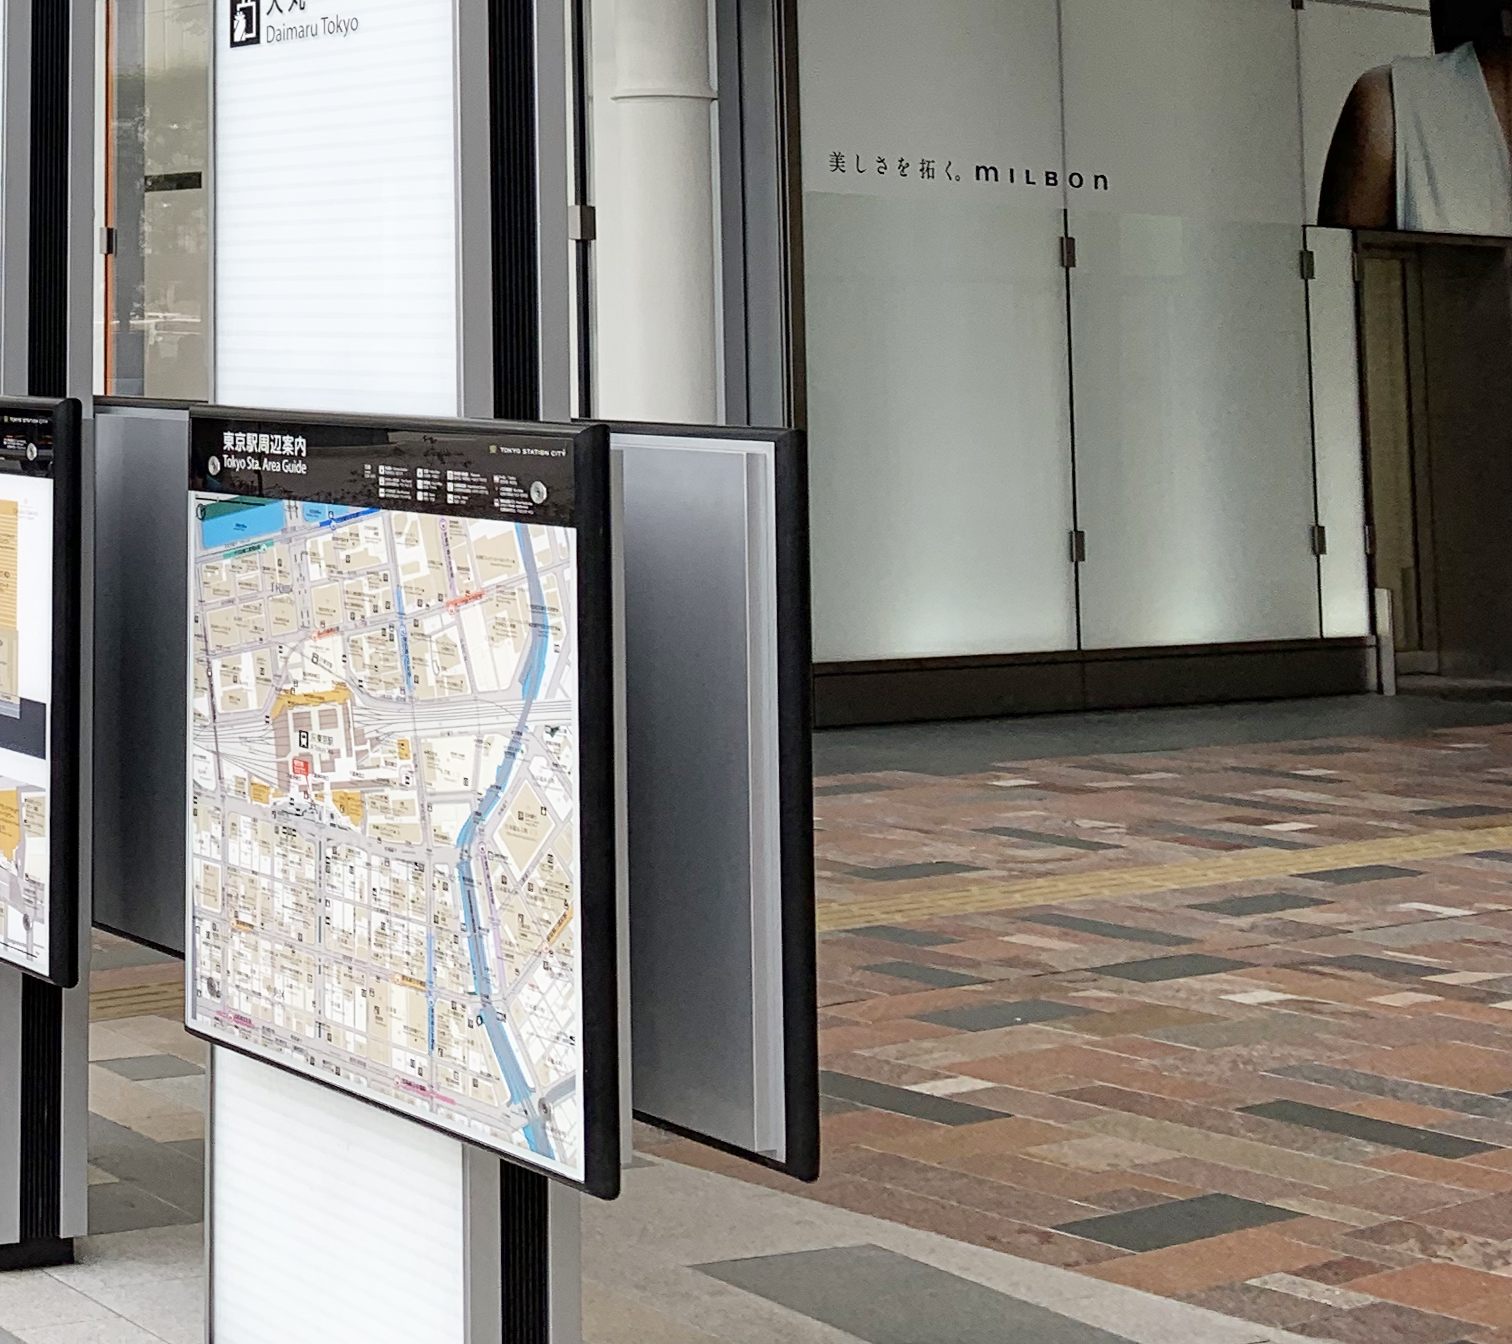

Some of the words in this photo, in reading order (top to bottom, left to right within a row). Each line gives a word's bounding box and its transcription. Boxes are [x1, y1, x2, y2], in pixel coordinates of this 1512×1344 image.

[266, 18, 318, 43] Daimaru
[321, 14, 359, 37] Tokyo
[499, 446, 521, 455] TOKYO
[522, 448, 549, 456] STATION
[550, 449, 566, 457] CITY
[223, 454, 245, 471] Tokyo
[247, 458, 261, 471] Sta.
[262, 460, 281, 473] Area
[282, 461, 307, 475] Guide
